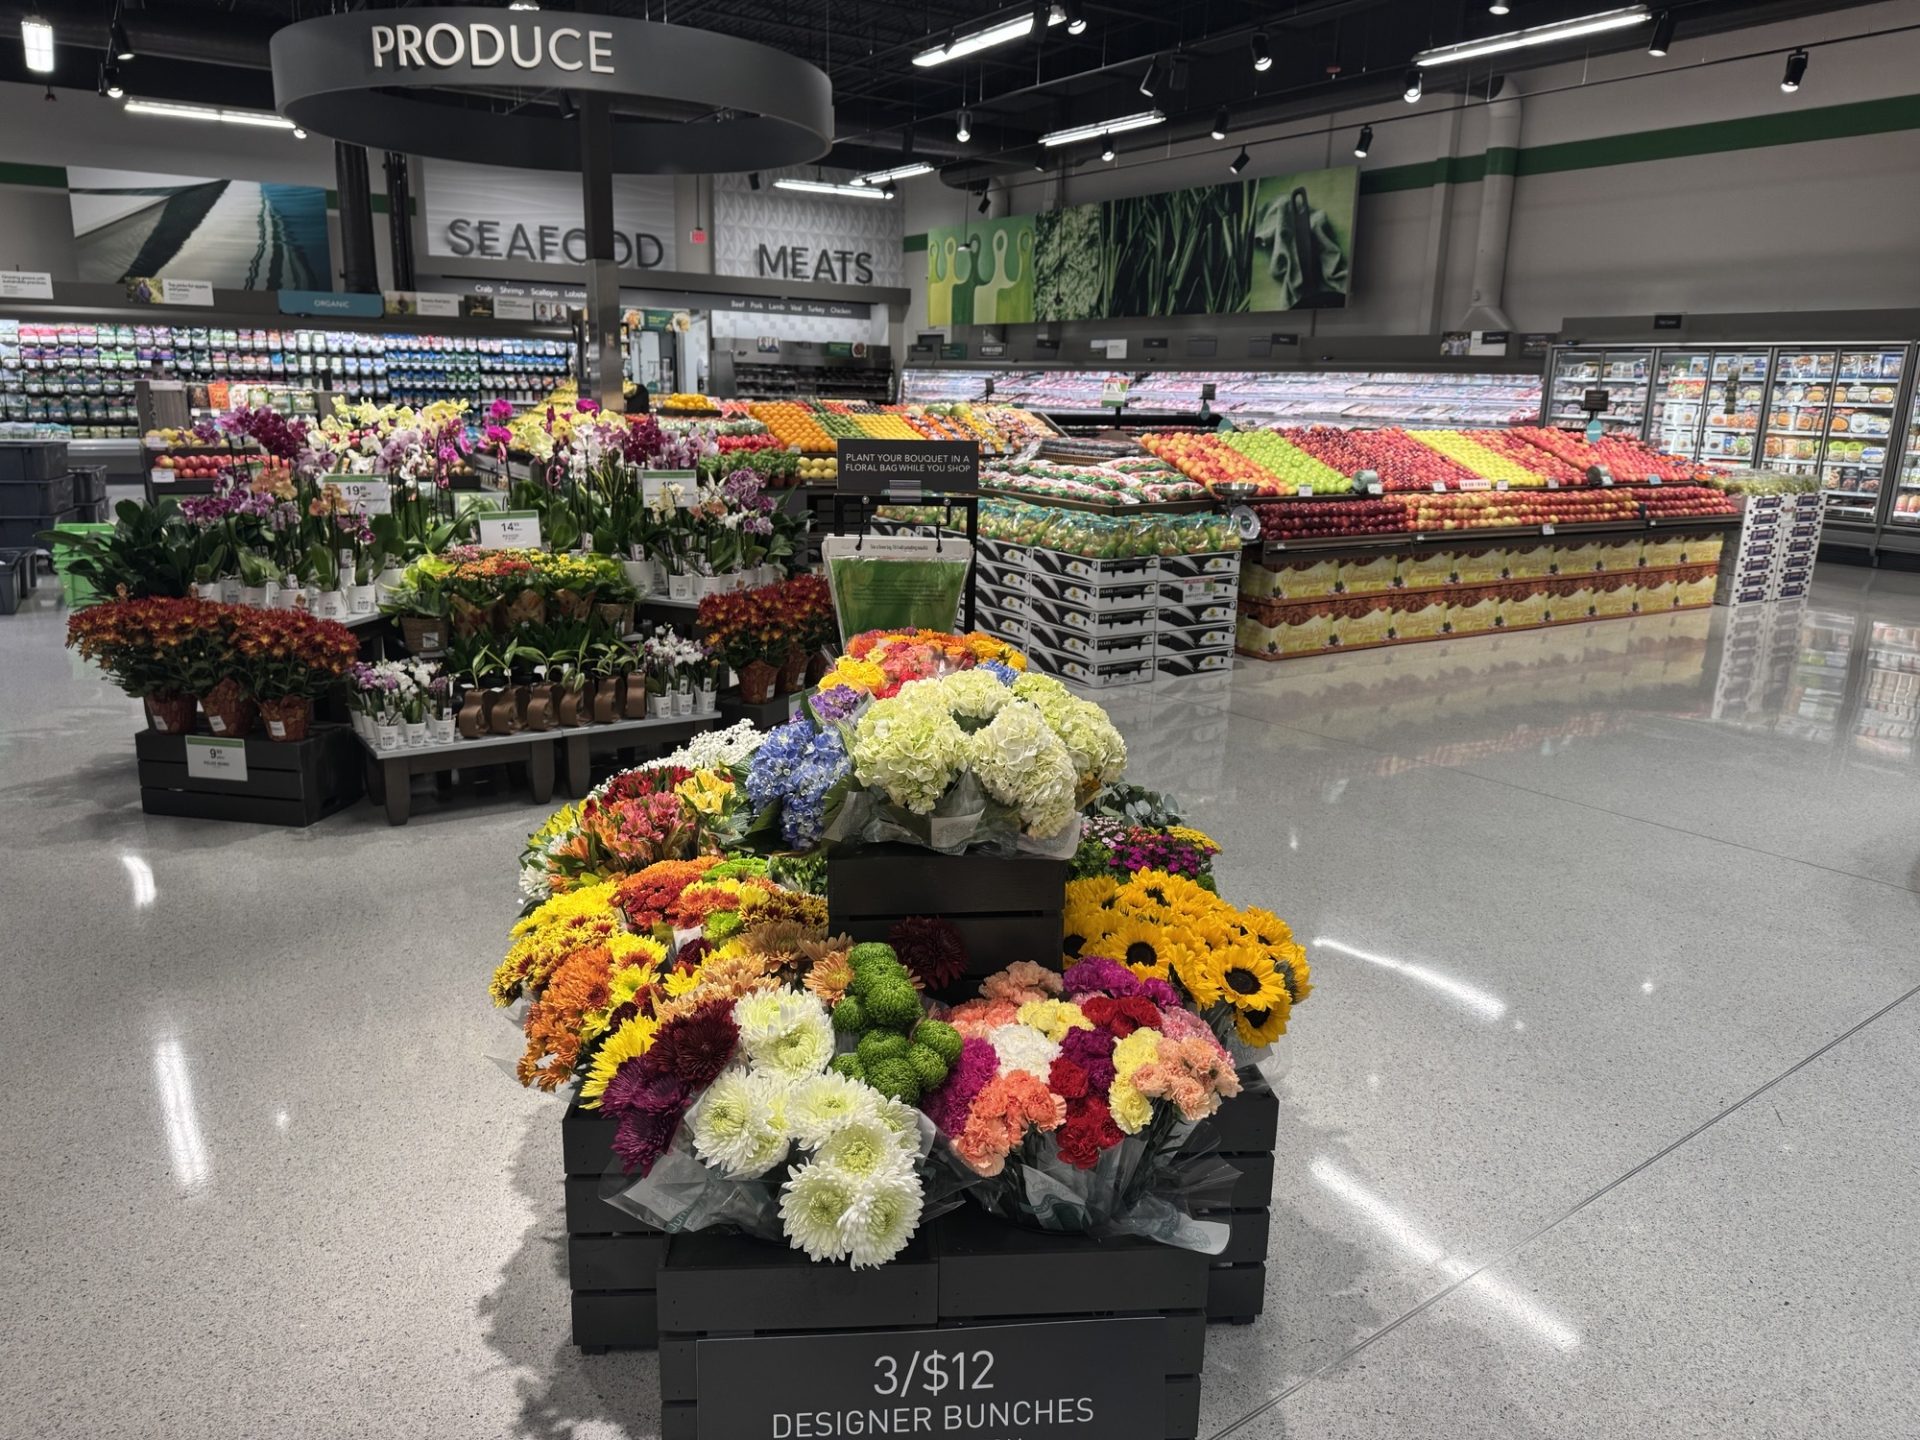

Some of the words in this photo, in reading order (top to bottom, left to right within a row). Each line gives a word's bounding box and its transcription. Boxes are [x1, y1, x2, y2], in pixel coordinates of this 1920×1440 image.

[371, 22, 615, 74] PRODUCE
[758, 243, 873, 284] MEATS
[475, 284, 493, 293] Crab
[499, 286, 524, 296] Shrimp
[530, 287, 559, 298] Scallops
[564, 290, 587, 298] Lobste
[314, 300, 349, 309] ORGANIC
[731, 300, 745, 308] Beef
[750, 301, 763, 309] Pork
[790, 304, 802, 312] Veal
[807, 305, 825, 315] Turkey
[830, 306, 852, 315] Chicken
[846, 453, 875, 462] PLANT
[877, 453, 902, 462] YOUR
[904, 454, 948, 463] BOUQUET
[951, 455, 960, 463] IN
[963, 455, 970, 463] A
[845, 463, 878, 472] FLORAL
[880, 464, 898, 472] BAG
[899, 464, 925, 472] WHILE
[927, 464, 946, 473] YOU
[947, 464, 971, 473] SHOP
[873, 1349, 994, 1398] 3/$12
[773, 1406, 932, 1439] DESIGNER
[944, 1397, 1094, 1430] BUNCHES
